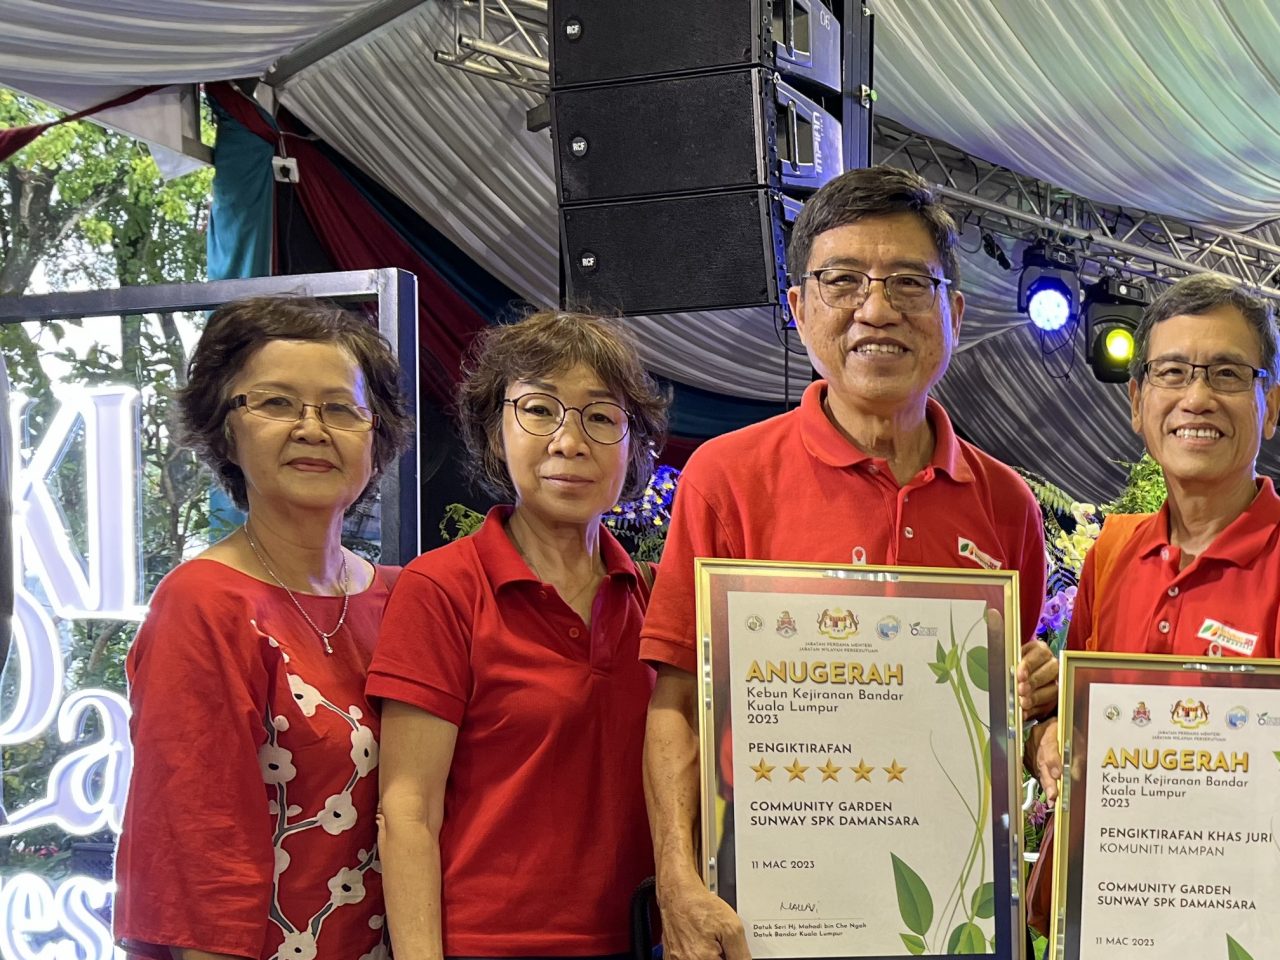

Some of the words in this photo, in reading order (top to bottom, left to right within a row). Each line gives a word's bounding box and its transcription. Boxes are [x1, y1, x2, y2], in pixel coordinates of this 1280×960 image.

[746, 660, 904, 685] ANUGERAH
[747, 687, 788, 699] Kebun
[793, 688, 853, 701] Kejiranan
[859, 690, 903, 701] Bandar
[747, 700, 784, 711] Kuala
[790, 701, 838, 713] Lumpur
[747, 714, 779, 725] 2023
[748, 742, 852, 754] PENGIKTIRAFAN
[1101, 748, 1249, 772] ANUGERAH
[1102, 773, 1139, 784] Kebun
[1144, 774, 1201, 786] Kejiranan
[1206, 776, 1248, 787] Bandar
[1102, 785, 1136, 796] Kuala
[1141, 786, 1186, 799] Lumpur
[750, 801, 834, 812] COMMUNITY
[838, 801, 892, 812] GARDEN
[1101, 798, 1130, 808] 2023
[750, 815, 807, 827] SUNWAY
[811, 815, 835, 826] SPK
[839, 815, 919, 827] DAMANSARA
[1100, 828, 1203, 841] PENGIKTIRAFAN
[1207, 830, 1243, 842] KHAS
[1246, 831, 1273, 843] JURI
[1099, 843, 1164, 855] KOMUNITI
[1168, 844, 1225, 856] MAMPAN
[751, 860, 759, 869] 11
[763, 860, 787, 869] MAC
[791, 860, 815, 869] 2023
[1098, 882, 1176, 893] COMMUNITY
[1180, 884, 1231, 895] GARDEN
[1097, 896, 1150, 908] SUNWAY
[1153, 897, 1176, 908] SPK
[1179, 898, 1256, 910] DAMANSARA
[1095, 937, 1102, 945] 11
[1106, 937, 1128, 946] MAC
[1132, 938, 1155, 947] 2023
